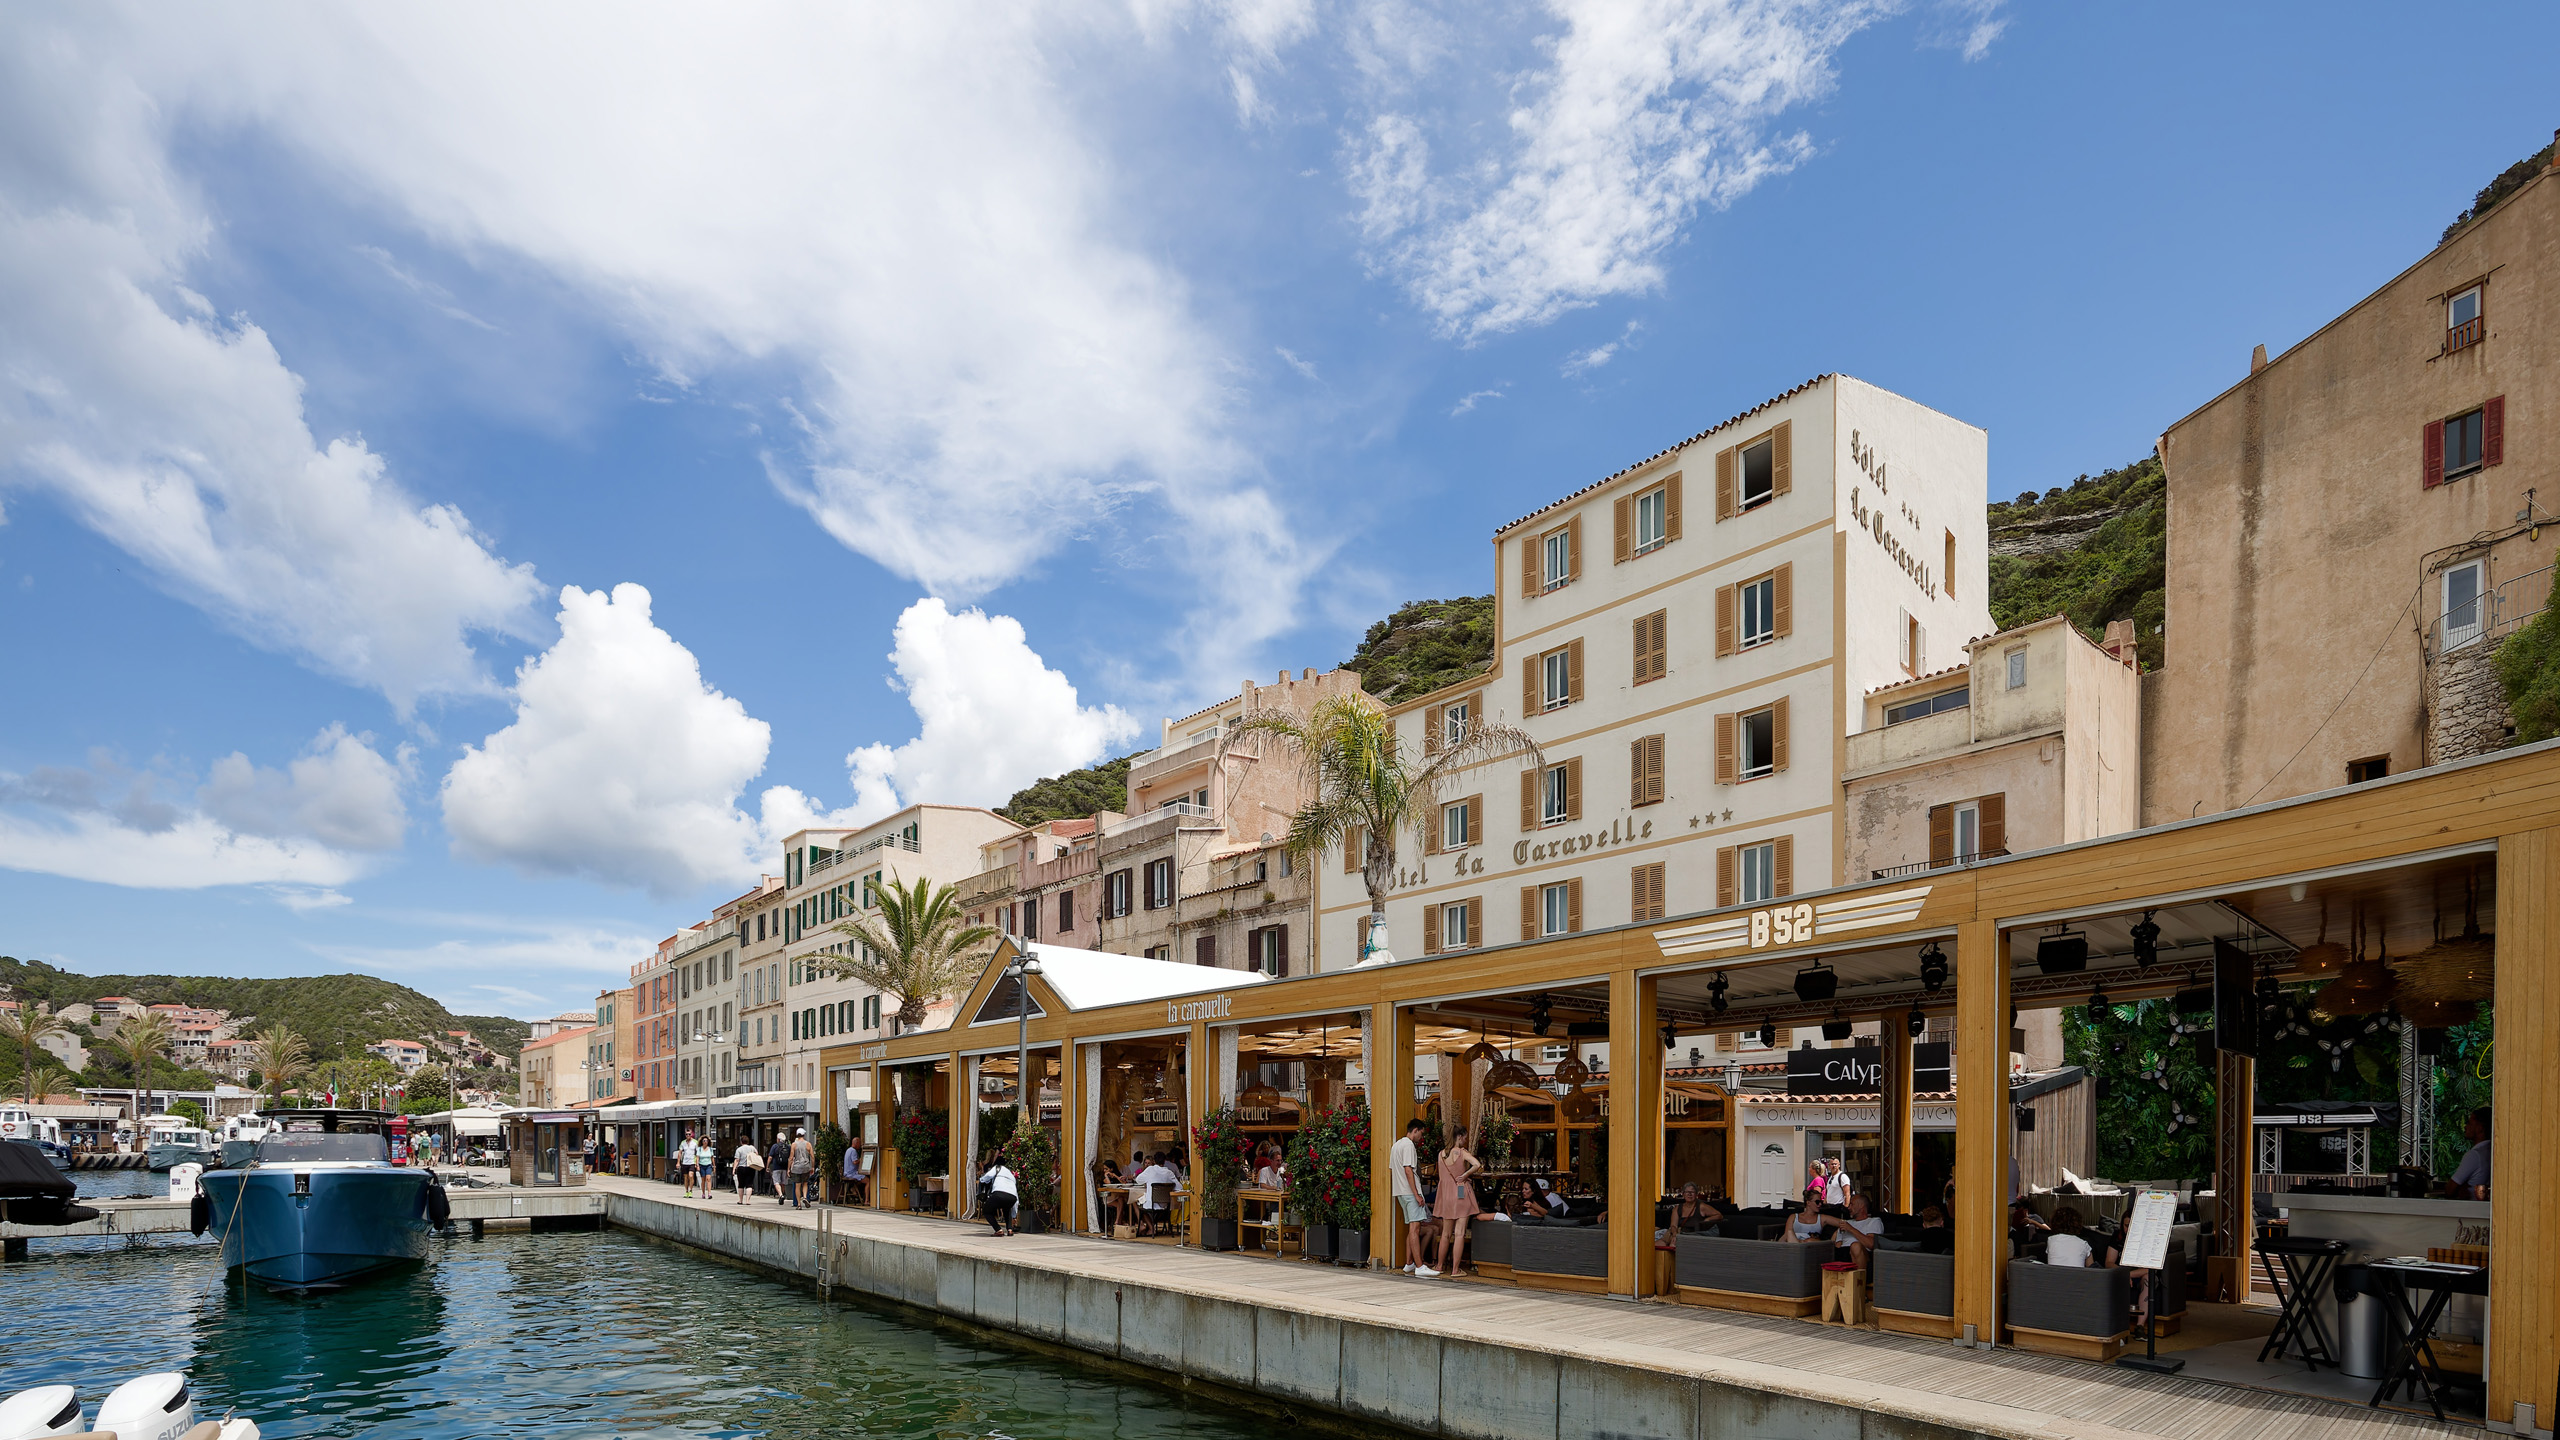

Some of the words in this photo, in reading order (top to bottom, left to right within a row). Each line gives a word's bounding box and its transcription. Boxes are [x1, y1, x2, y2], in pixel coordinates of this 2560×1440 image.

[1850, 485, 1869, 531] La
[1872, 509, 1936, 602] Caravelle
[1455, 852, 1485, 877] La
[1513, 815, 1653, 866] Caravelle
[1168, 1001, 1178, 1024] la
[1181, 994, 1232, 1021] caravelle
[1756, 1108, 1808, 1121] CORAIL
[1824, 1107, 1877, 1121] BIJOUX
